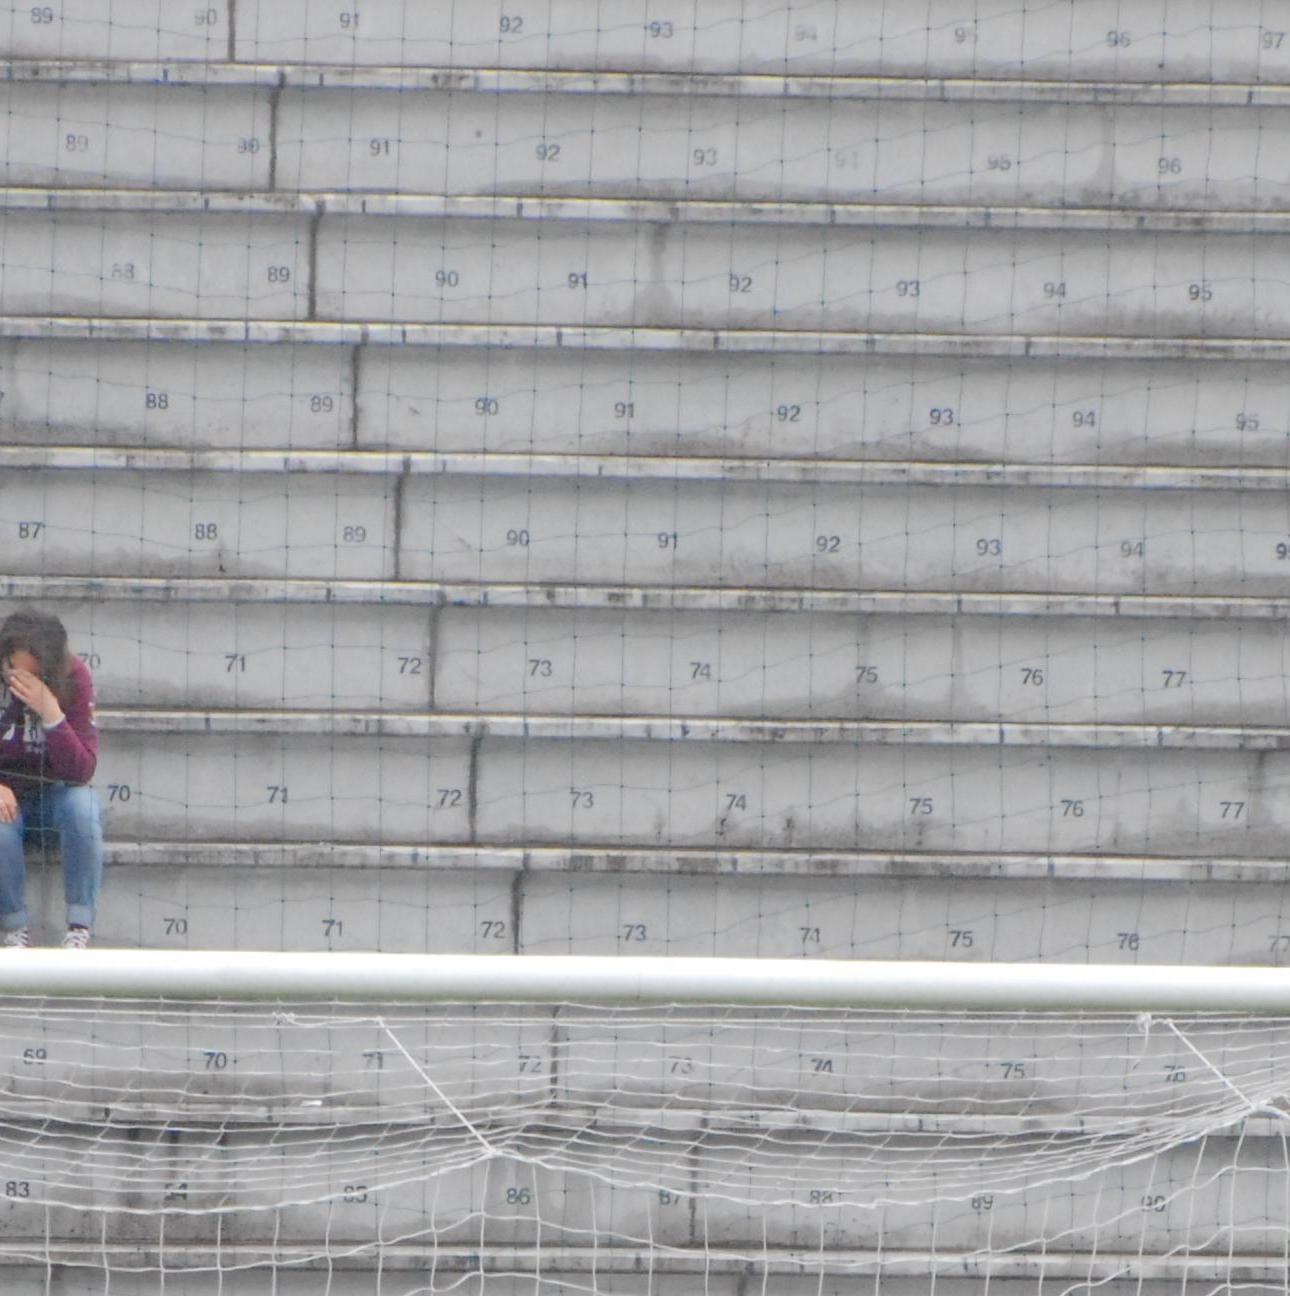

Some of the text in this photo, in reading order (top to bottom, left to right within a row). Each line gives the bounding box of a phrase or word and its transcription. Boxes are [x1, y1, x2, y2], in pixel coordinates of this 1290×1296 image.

[339, 12, 360, 30] 91
[499, 15, 524, 35] 92
[648, 21, 675, 39] 93
[1262, 31, 1286, 50] 97
[370, 138, 391, 157] 91
[536, 143, 561, 162] 92
[1158, 157, 1182, 175] 96
[267, 266, 291, 284] 89
[435, 269, 460, 288] 90
[568, 272, 590, 290] 91
[729, 275, 753, 294] 92
[896, 279, 922, 299] 93
[1044, 282, 1067, 299] 94
[1188, 283, 1213, 302] 95
[145, 392, 170, 411] 88
[614, 402, 636, 420] 91
[775, 405, 802, 423] 92
[929, 408, 955, 427] 93
[1073, 411, 1097, 428] 94
[19, 521, 43, 540] 87
[195, 523, 219, 541] 88
[343, 526, 367, 544] 89
[507, 529, 532, 548] 90
[657, 531, 680, 550] 91
[816, 535, 842, 554] 92
[976, 538, 1003, 557] 93
[1120, 540, 1147, 559] 94
[225, 653, 247, 673] 71
[395, 656, 422, 678] 72
[528, 659, 553, 678] 73
[690, 662, 713, 682] 74
[856, 665, 879, 685] 75
[1021, 667, 1045, 687] 76
[1162, 669, 1189, 689] 77
[107, 784, 132, 803] 70
[267, 785, 290, 805] 71
[435, 787, 463, 809] 72
[570, 791, 595, 810] 73
[723, 792, 748, 814] 74
[910, 798, 934, 816] 75
[1061, 799, 1085, 819] 76
[1220, 801, 1245, 818] 77
[164, 918, 189, 936] 70
[322, 918, 344, 939] 71
[479, 920, 507, 940] 72
[623, 924, 649, 944] 73
[948, 930, 975, 949] 75
[5, 1181, 31, 1198] 83
[507, 1187, 532, 1206] 86
